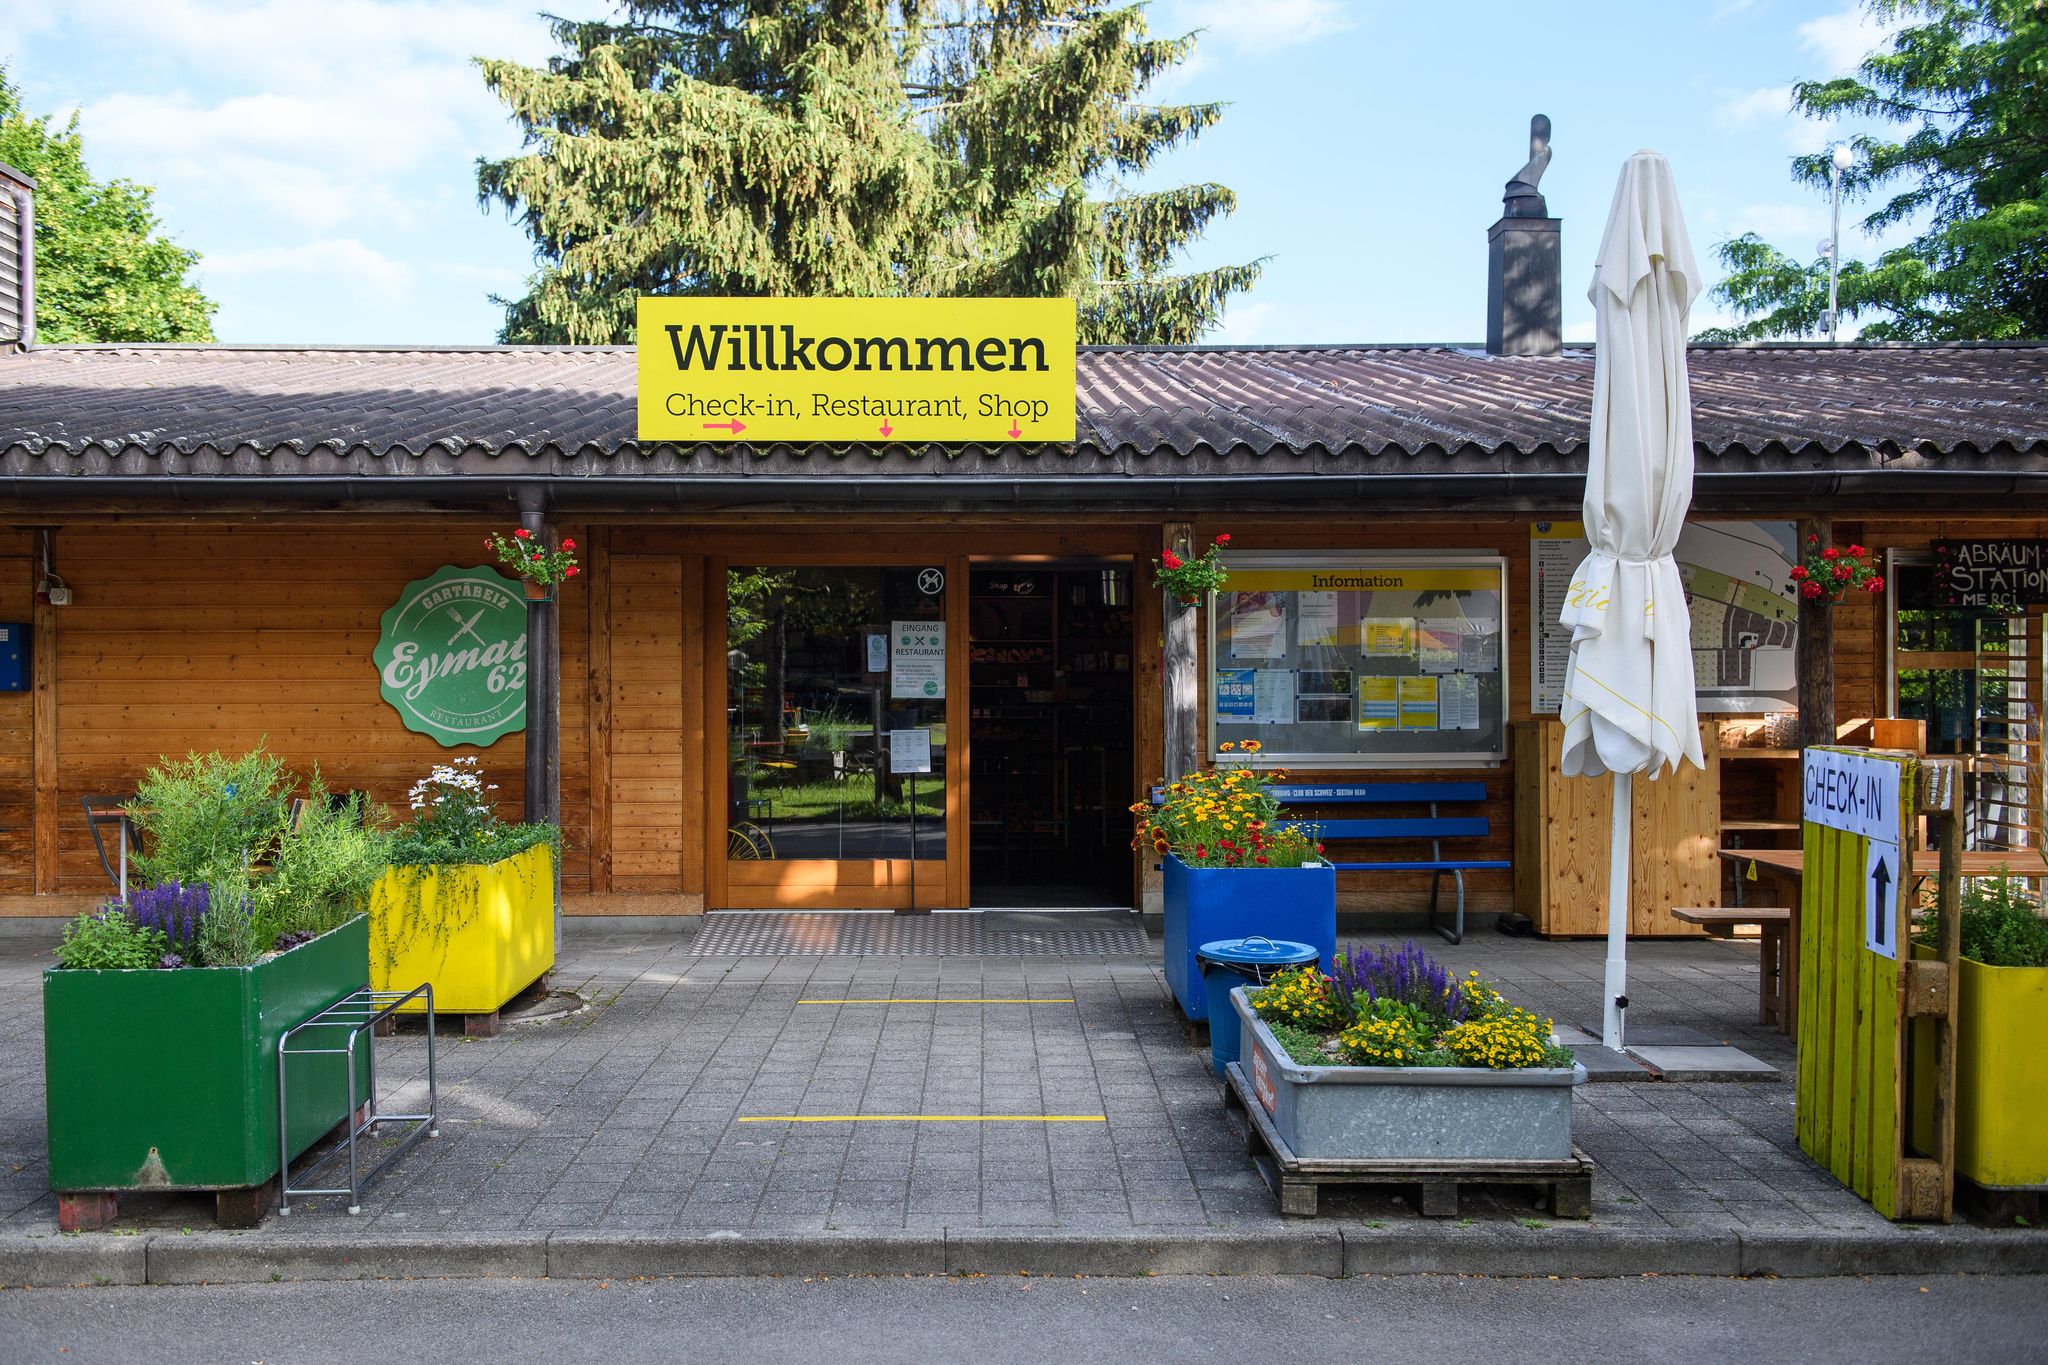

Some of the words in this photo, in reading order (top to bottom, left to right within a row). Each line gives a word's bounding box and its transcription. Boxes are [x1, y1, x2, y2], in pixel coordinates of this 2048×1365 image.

[664, 324, 1050, 372] Willkommen
[665, 393, 801, 419] Check-in,
[811, 393, 968, 419] Restaurant,
[977, 393, 1049, 423] Shop
[1957, 542, 2041, 571] ABRÄUM
[1312, 574, 1404, 588] Information
[421, 582, 511, 610] GARTÄBEIZ
[901, 623, 939, 633] EINGANG
[383, 632, 527, 701] Eymat
[895, 648, 945, 656] RESTAURANT
[487, 661, 527, 694] 62
[429, 708, 503, 728] RESTAURANT
[1804, 763, 1883, 822] CHECK-IN
